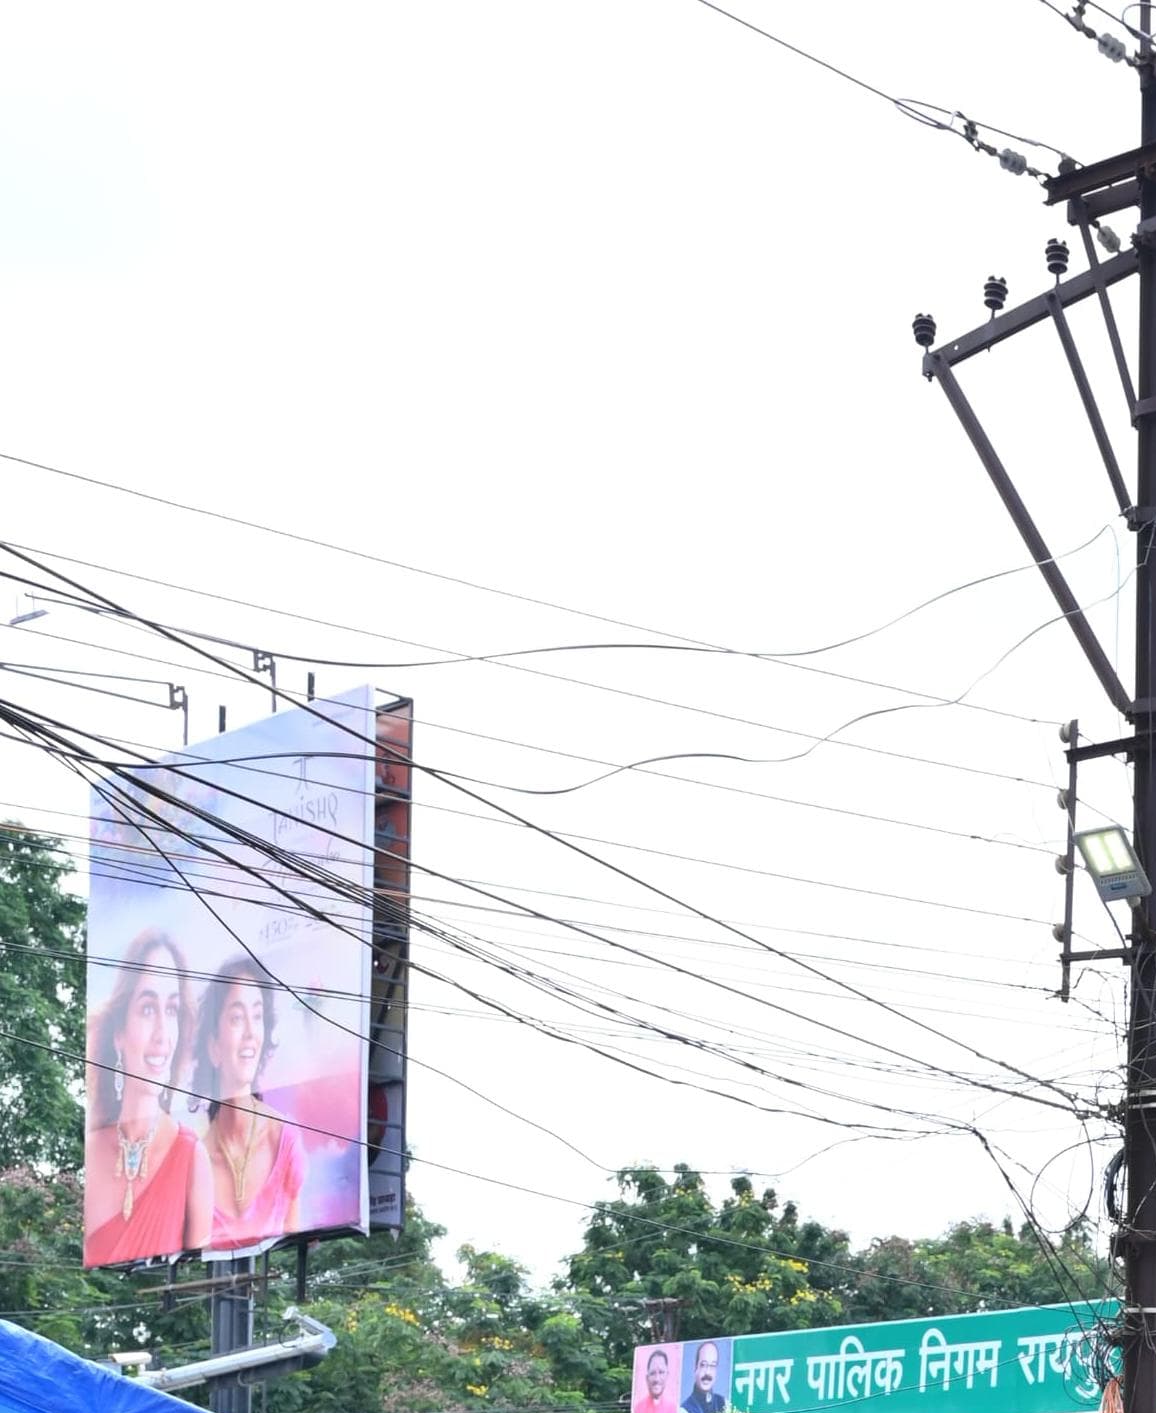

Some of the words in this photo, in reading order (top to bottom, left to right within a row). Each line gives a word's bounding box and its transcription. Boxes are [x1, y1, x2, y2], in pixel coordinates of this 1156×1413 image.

[734, 1357, 794, 1405] नगर
[806, 1335, 905, 1400] पालिक
[918, 1328, 1002, 1391] निगम
